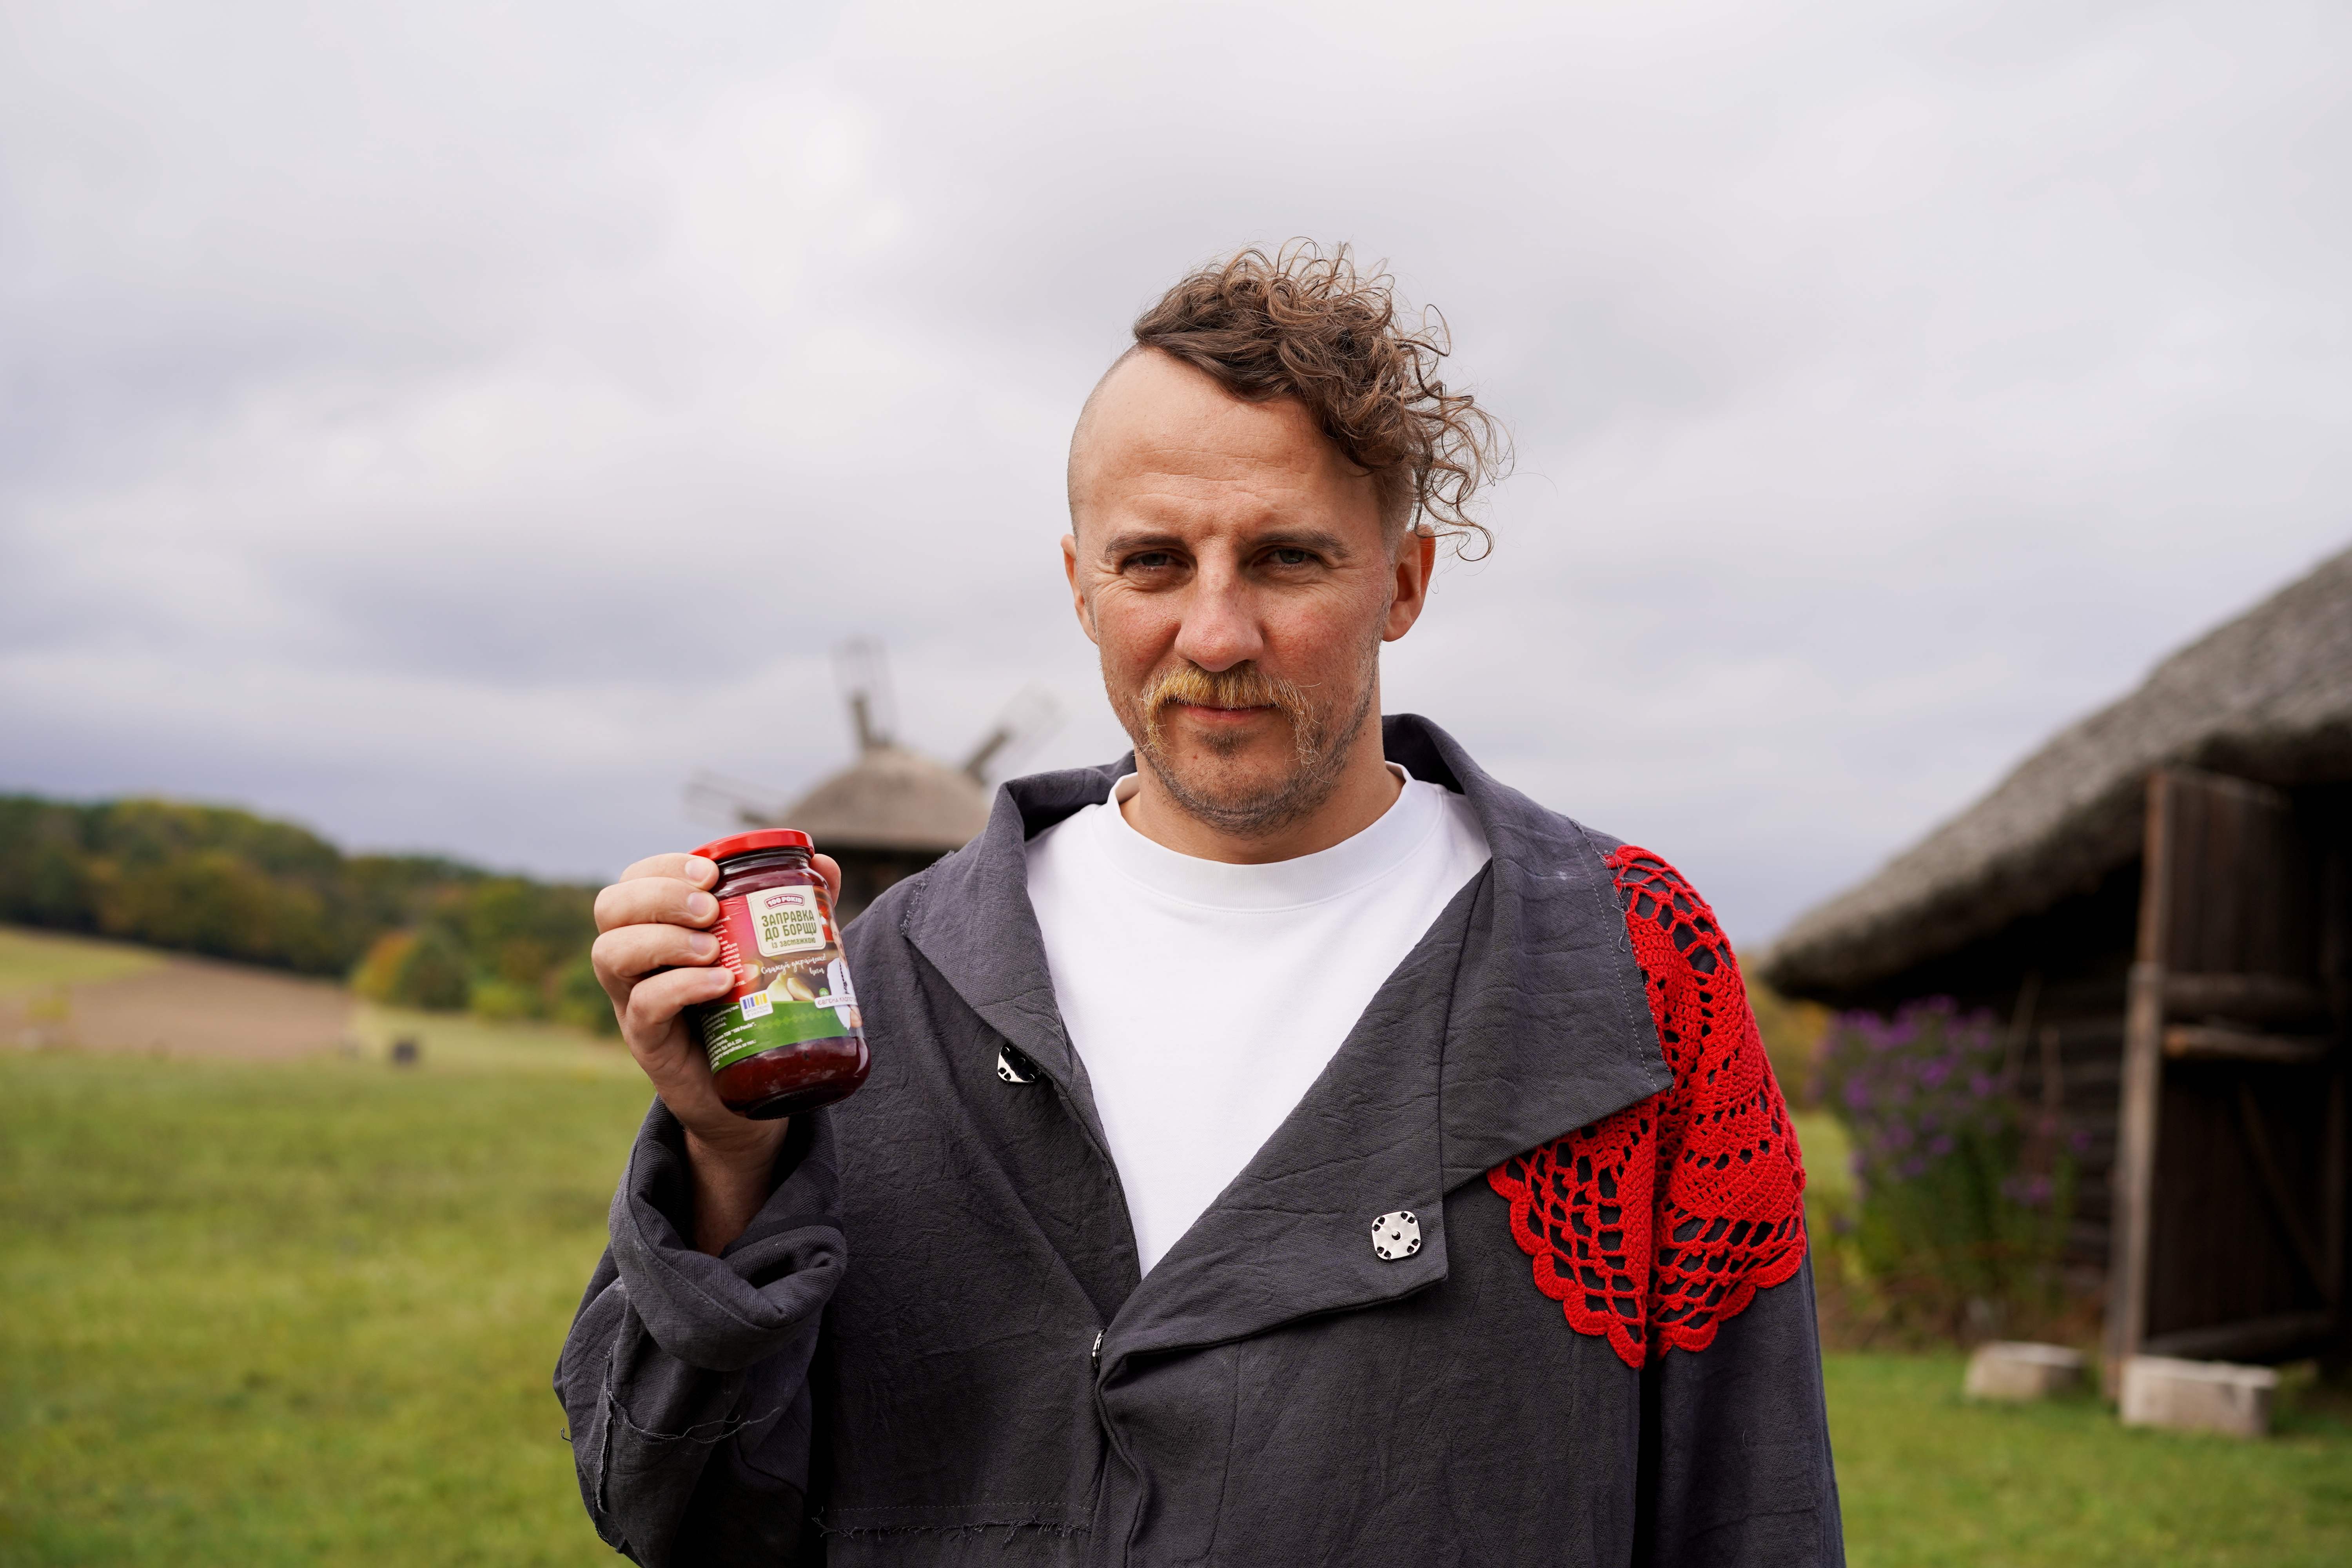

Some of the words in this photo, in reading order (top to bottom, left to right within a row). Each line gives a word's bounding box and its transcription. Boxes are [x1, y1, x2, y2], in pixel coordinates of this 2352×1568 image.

[768, 897, 781, 906] 100
[761, 909, 815, 927] ЗАПРАВКА
[765, 926, 779, 942] ДО
[782, 922, 817, 936] БОРЩУ
[780, 937, 816, 947] засмажкою
